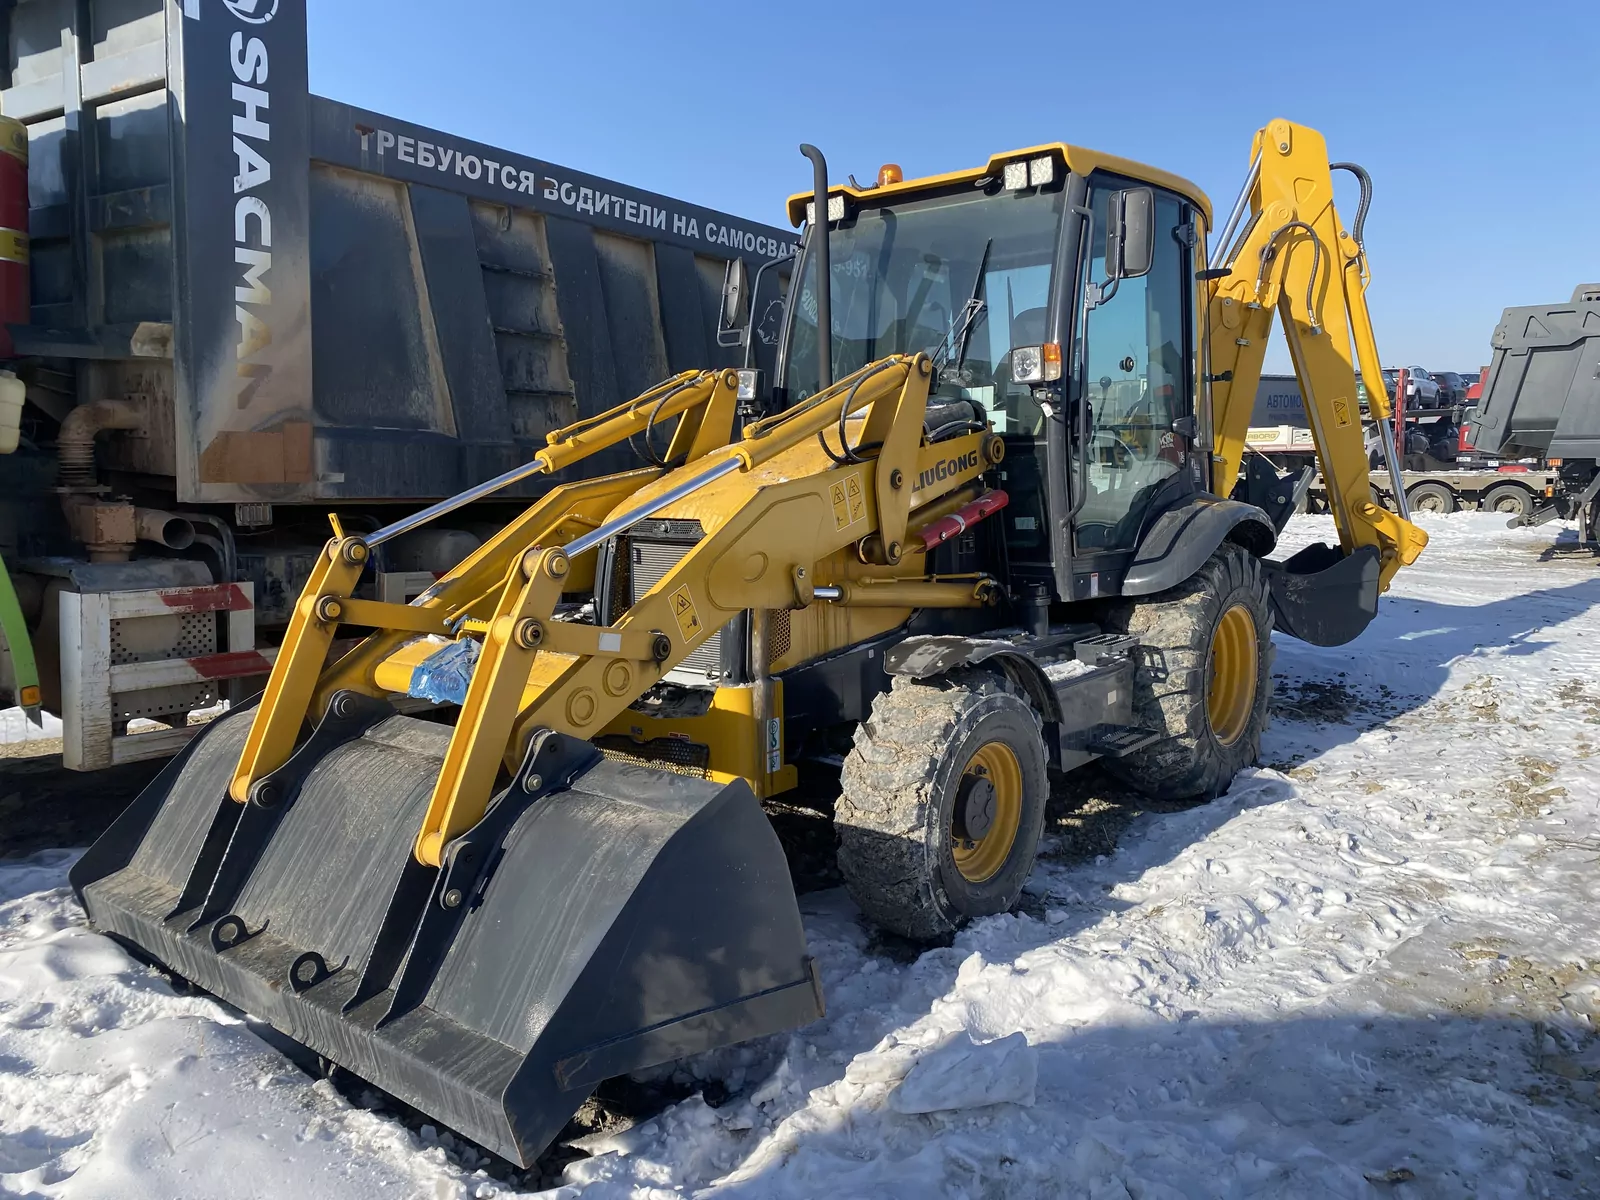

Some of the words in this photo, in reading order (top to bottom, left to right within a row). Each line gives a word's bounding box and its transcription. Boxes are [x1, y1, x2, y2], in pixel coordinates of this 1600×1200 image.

[355, 124, 535, 195] ТРЕБУЮТСЯ
[543, 177, 666, 230] ВОДИТЕЛИ
[673, 213, 700, 239] НА
[1267, 394, 1304, 408] АВТОМО
